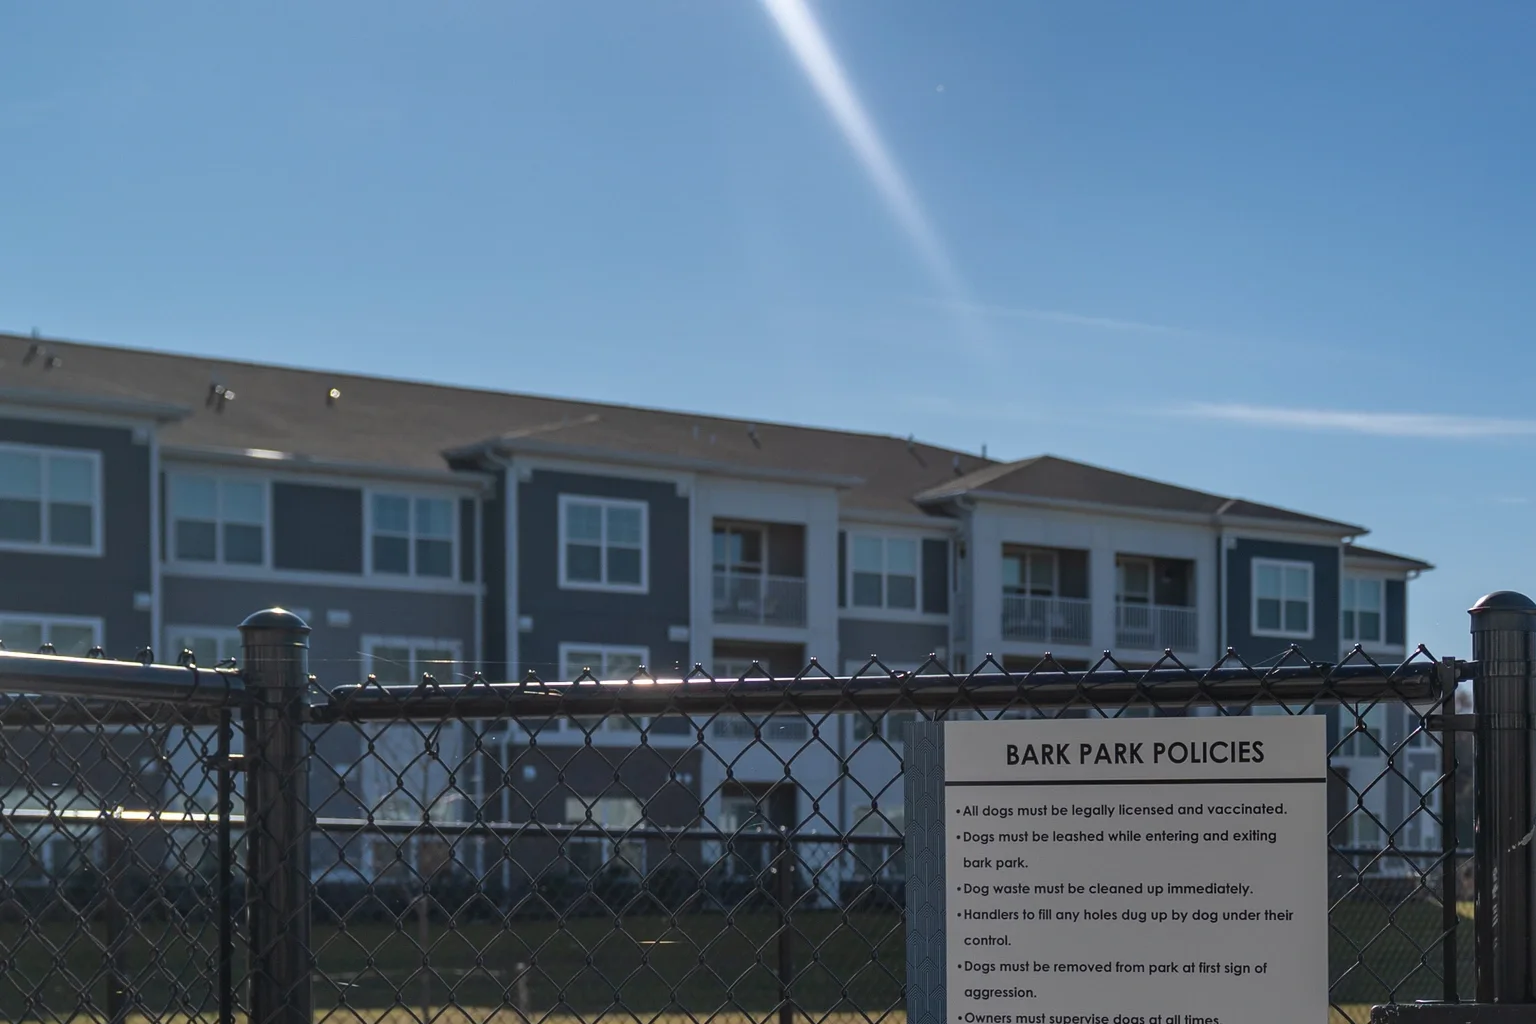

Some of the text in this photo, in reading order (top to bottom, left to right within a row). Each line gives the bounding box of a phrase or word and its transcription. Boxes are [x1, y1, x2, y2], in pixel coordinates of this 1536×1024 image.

[1007, 740, 1264, 765] BARK PARK POLICIES
[963, 803, 1287, 819] All dogs must be legally licensed and vaccinated.
[963, 829, 1277, 845] Dogs must be leashed while entering and exiting
[963, 857, 1028, 871] bark park.
[964, 882, 1253, 897] Dog waste must be cleaned up immediately.
[964, 909, 1294, 923] Handlers to fill any holes dug up by dog under their
[964, 935, 1011, 946] control.
[964, 960, 1267, 976] Dogs must be removed from park at first sign of
[964, 987, 1037, 1000] aggression.
[964, 1012, 1012, 1024] Owners
[1016, 1013, 1046, 1024] must
